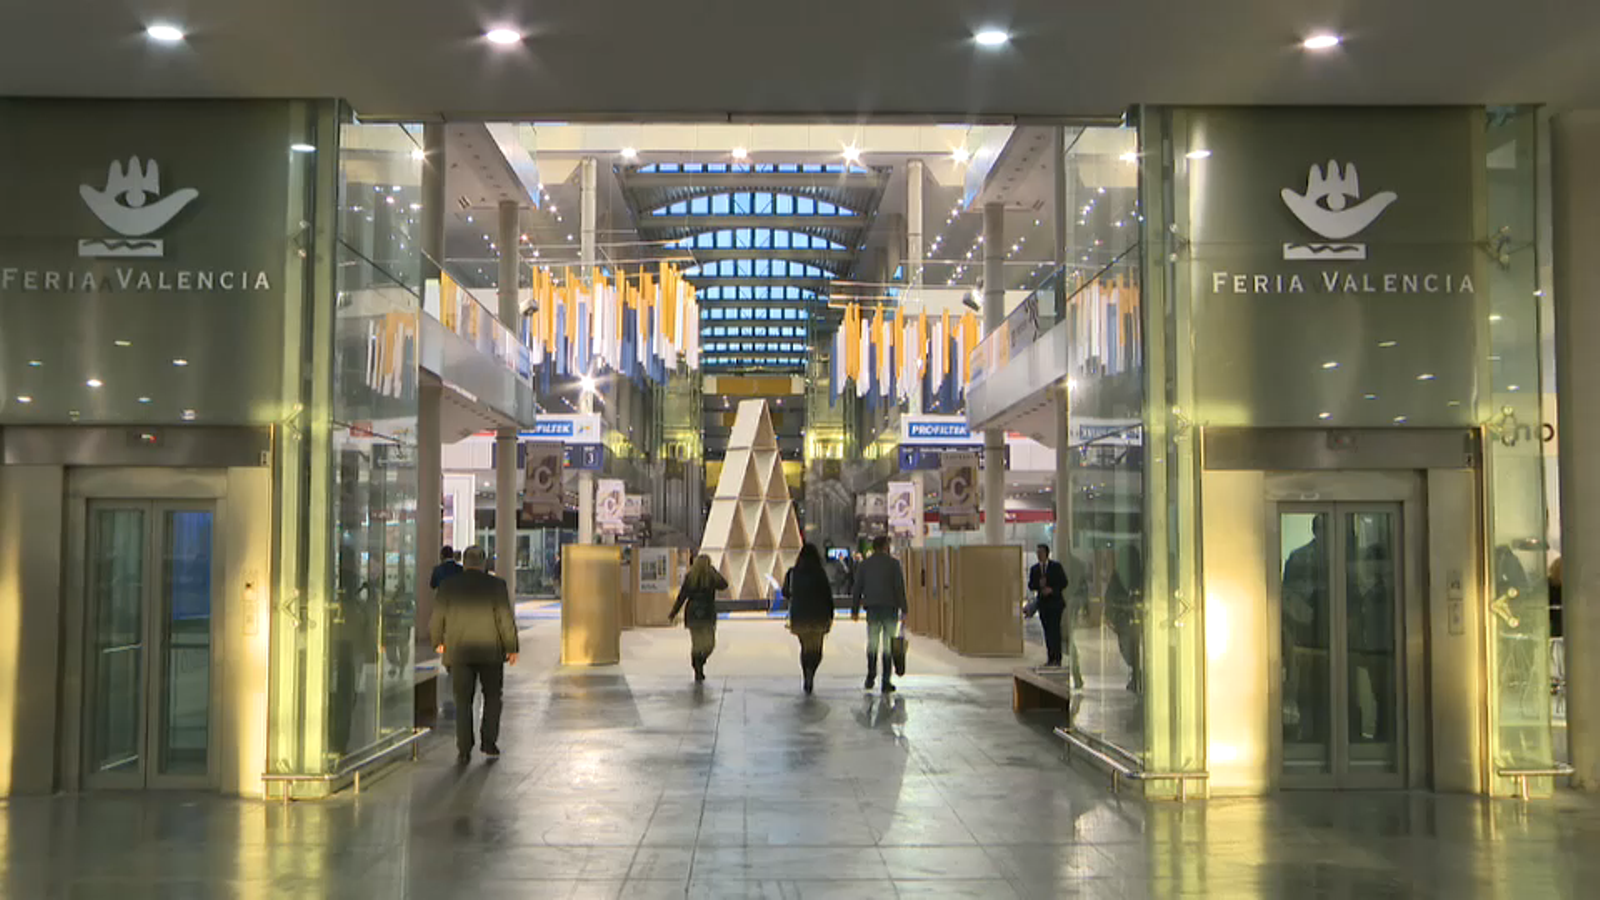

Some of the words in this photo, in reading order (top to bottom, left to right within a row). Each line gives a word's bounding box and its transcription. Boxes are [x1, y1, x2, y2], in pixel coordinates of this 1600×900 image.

[1, 267, 98, 290] FERIA
[116, 267, 271, 290] VALENCIA
[1212, 271, 1305, 294] FERIA
[1322, 271, 1475, 294] VALENCIA
